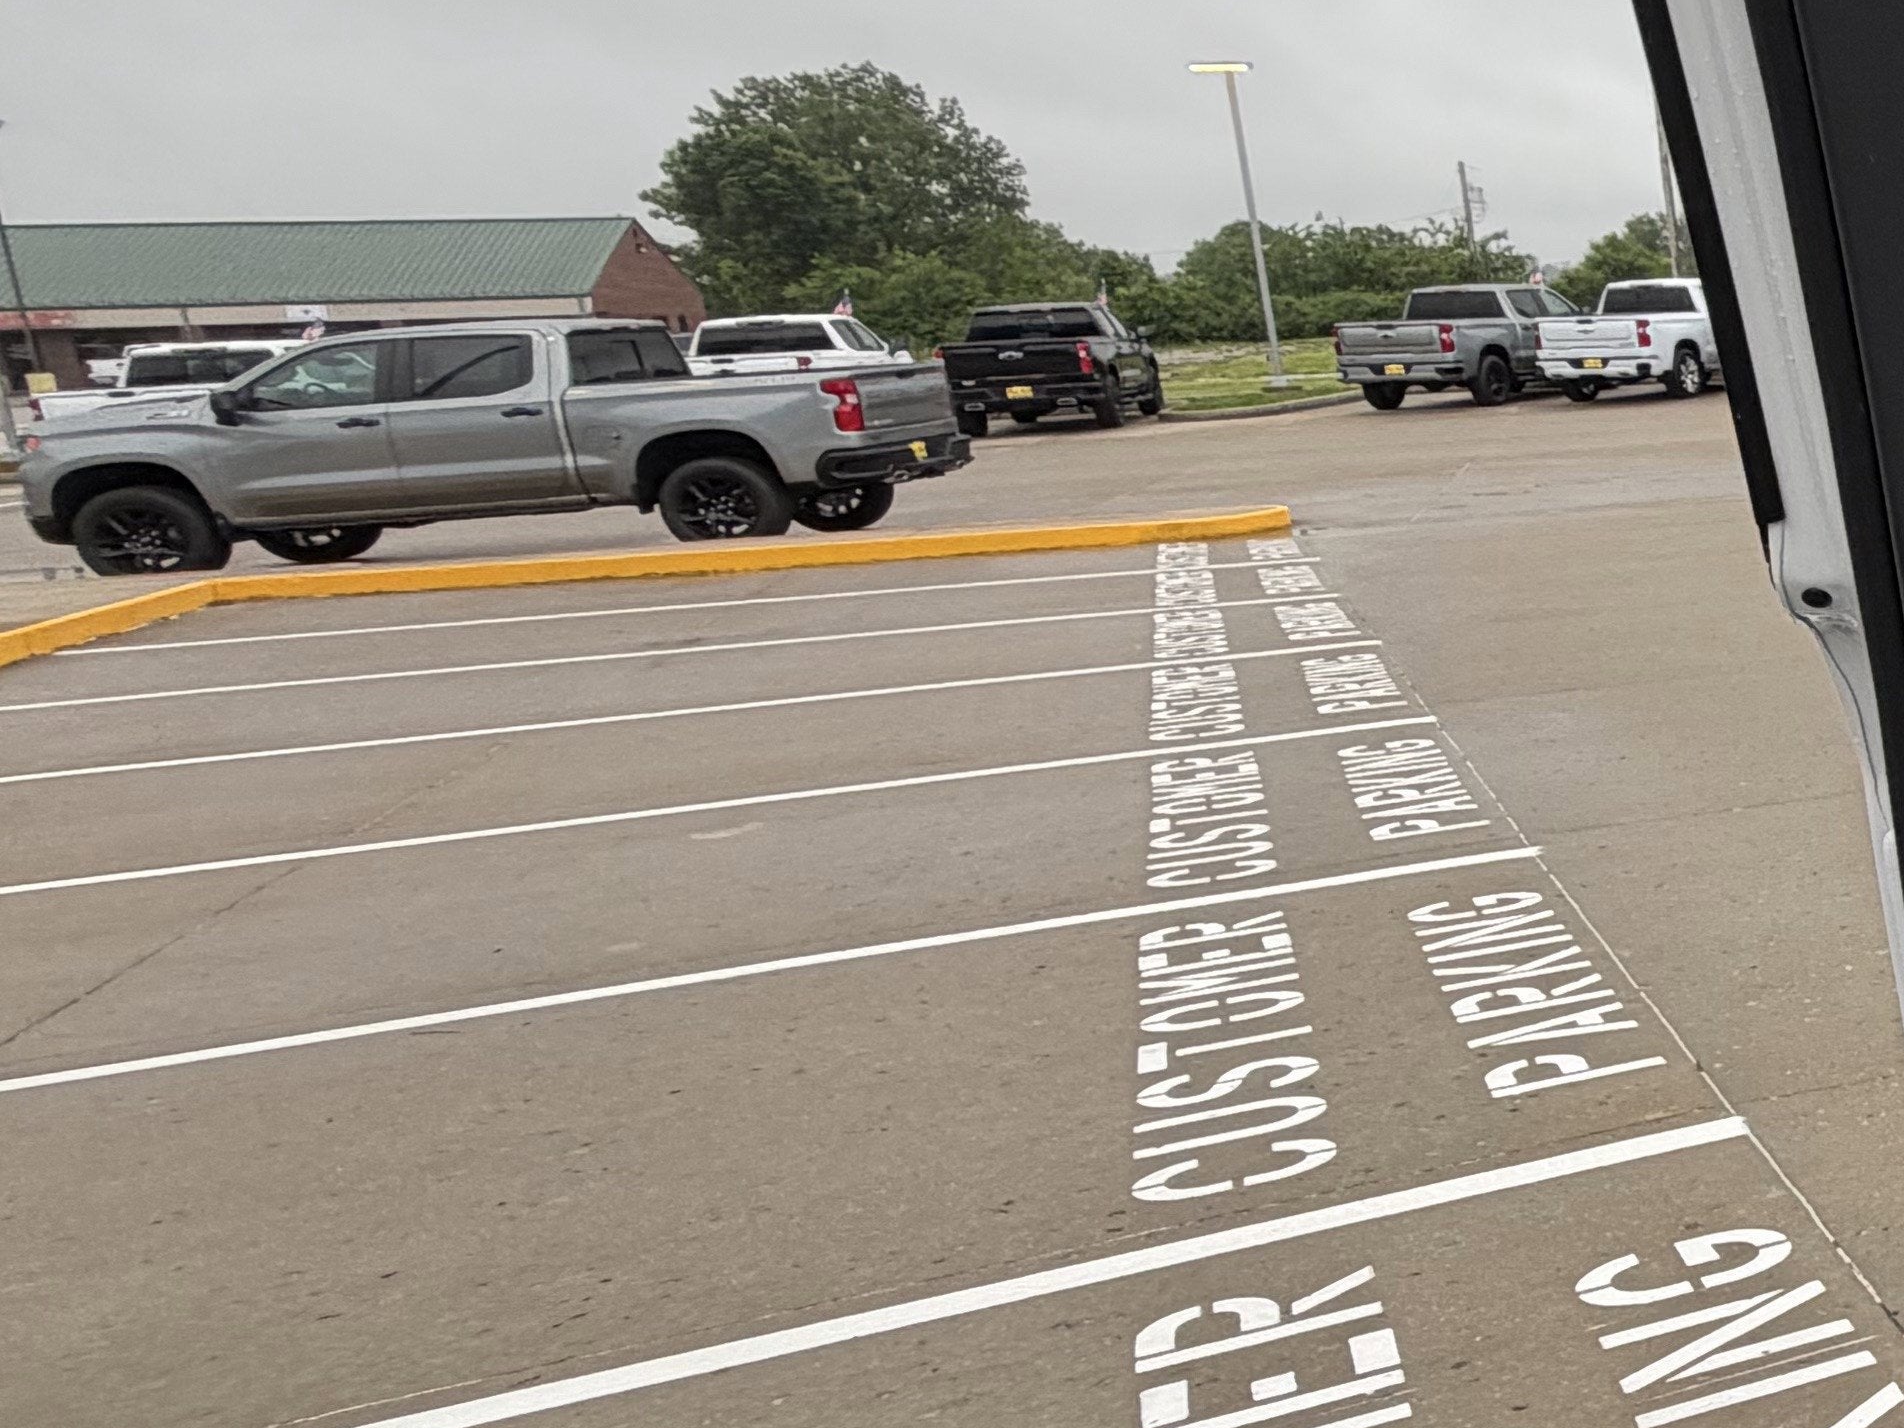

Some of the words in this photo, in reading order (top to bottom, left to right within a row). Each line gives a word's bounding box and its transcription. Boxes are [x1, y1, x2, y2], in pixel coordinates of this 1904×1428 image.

[1146, 750, 1278, 888] CUSTOMER
[1337, 738, 1490, 841] PARKING
[1131, 910, 1337, 1202] CUSTOMER
[1406, 891, 1668, 1099] PARKING
